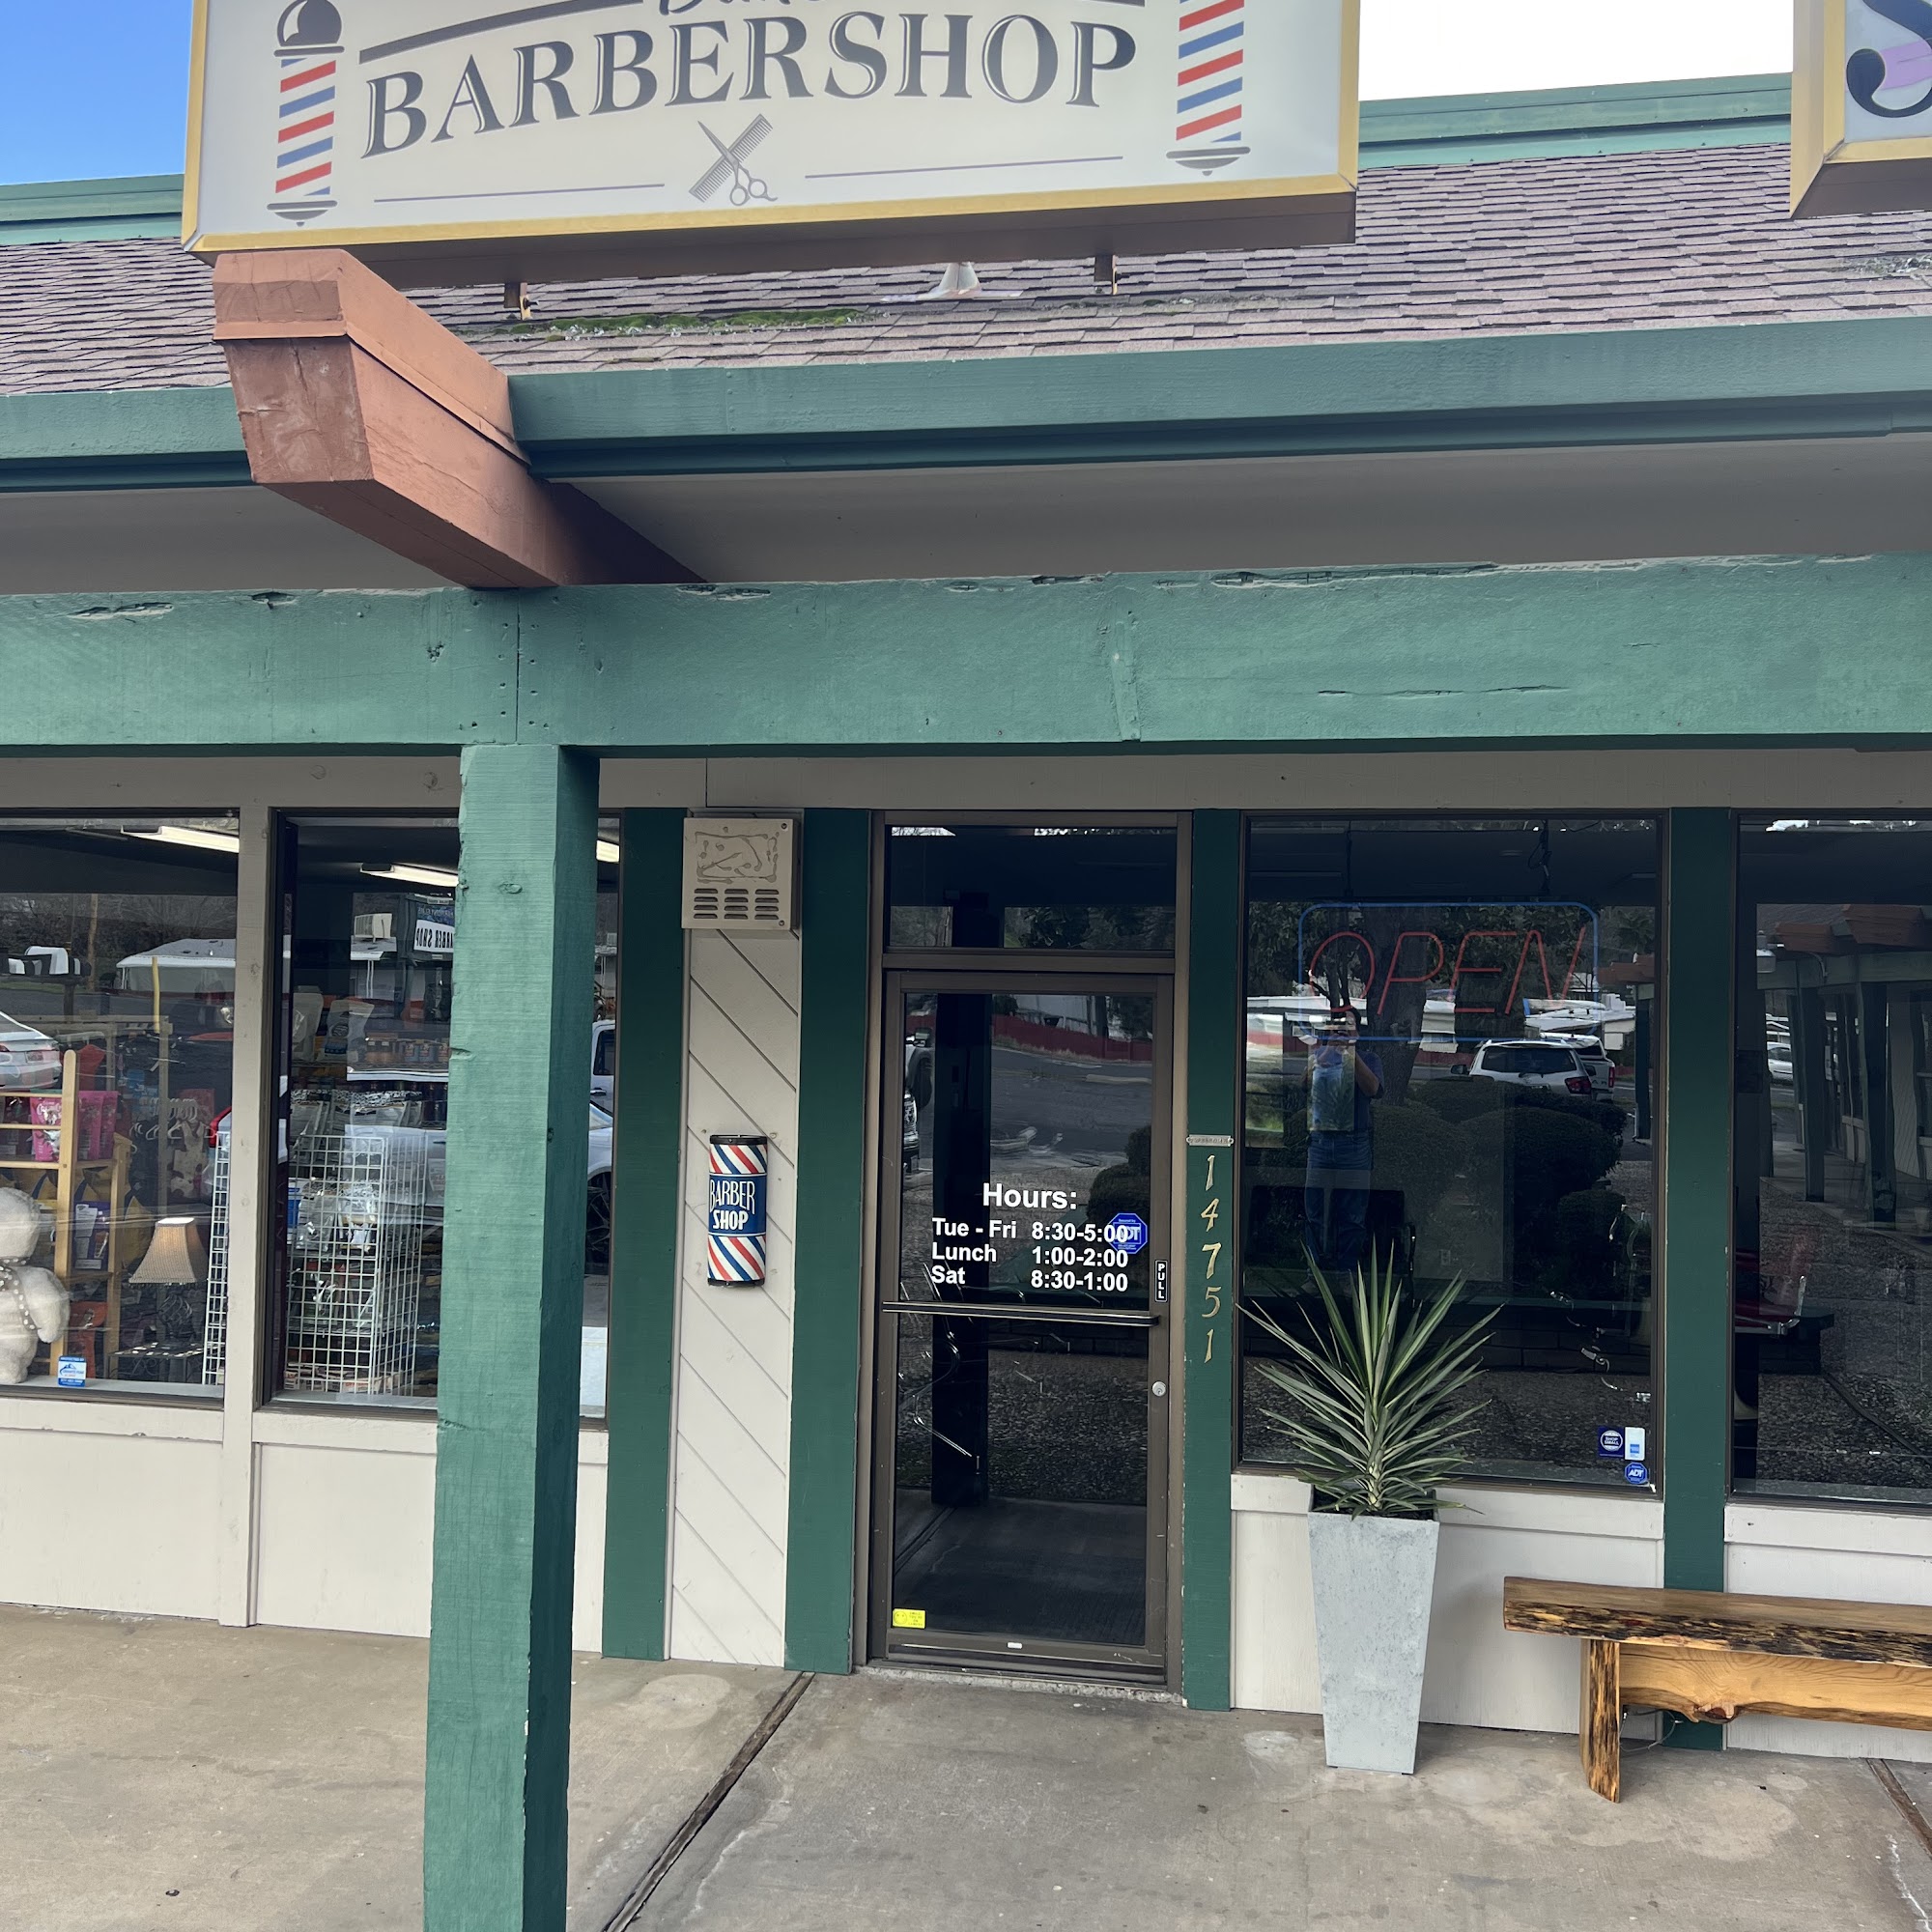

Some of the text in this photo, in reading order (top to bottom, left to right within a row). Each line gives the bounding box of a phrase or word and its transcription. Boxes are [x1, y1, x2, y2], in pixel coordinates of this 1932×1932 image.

[360, 11, 1136, 159] BARBERSHOP
[1310, 926, 1586, 1014] OPEN
[709, 1179, 755, 1215] BARBER
[982, 1182, 1077, 1210] Hours:
[712, 1209, 749, 1231] SHOP
[931, 1217, 970, 1236] Tue
[988, 1219, 1017, 1239] Fri
[1031, 1222, 1129, 1244] 8:30-5:00
[931, 1241, 1129, 1268] Lunch 1:00-2:00
[930, 1264, 1129, 1293] Sat 8:30-1:00
[1157, 1263, 1166, 1299] PULL
[1628, 1468, 1644, 1478] ADT
